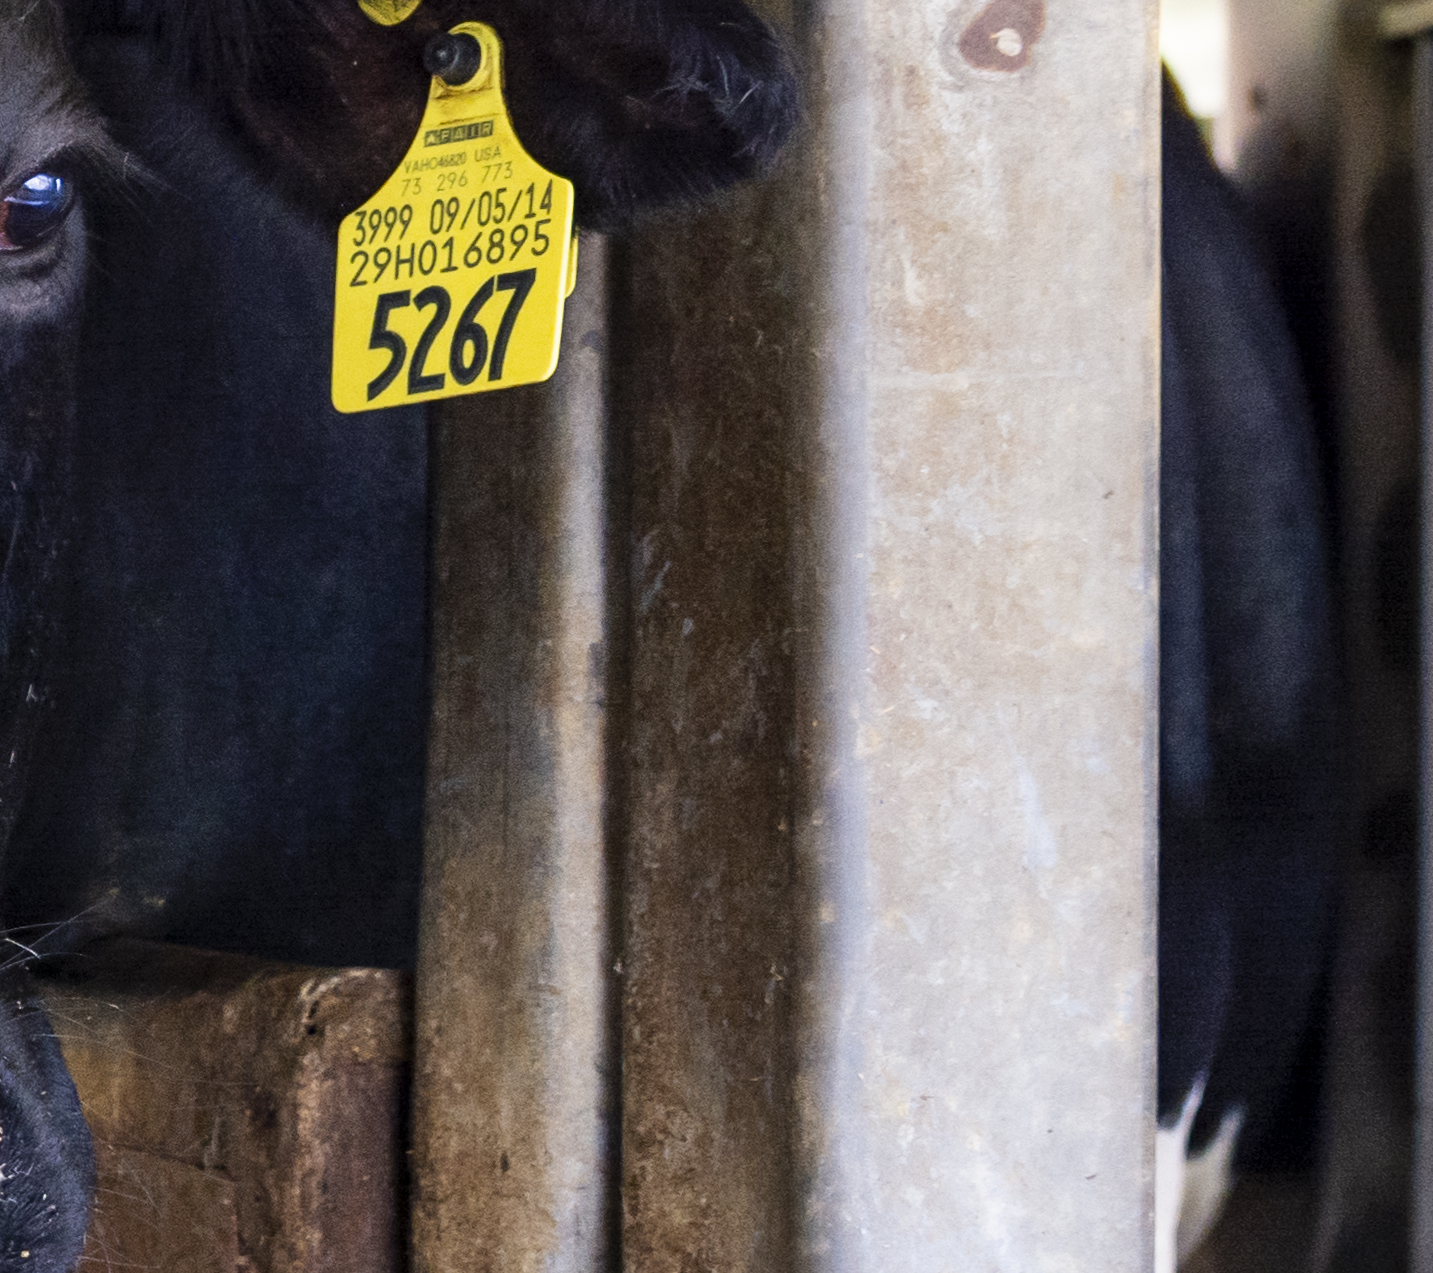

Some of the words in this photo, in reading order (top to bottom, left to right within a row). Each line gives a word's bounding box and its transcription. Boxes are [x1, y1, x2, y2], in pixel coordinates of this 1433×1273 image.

[401, 176, 422, 197] 73
[436, 169, 469, 192] 296
[482, 160, 514, 184] 773
[474, 145, 502, 163] USA
[352, 204, 414, 247] 3999
[429, 178, 553, 236] 09/05/14
[366, 267, 537, 402] 5267
